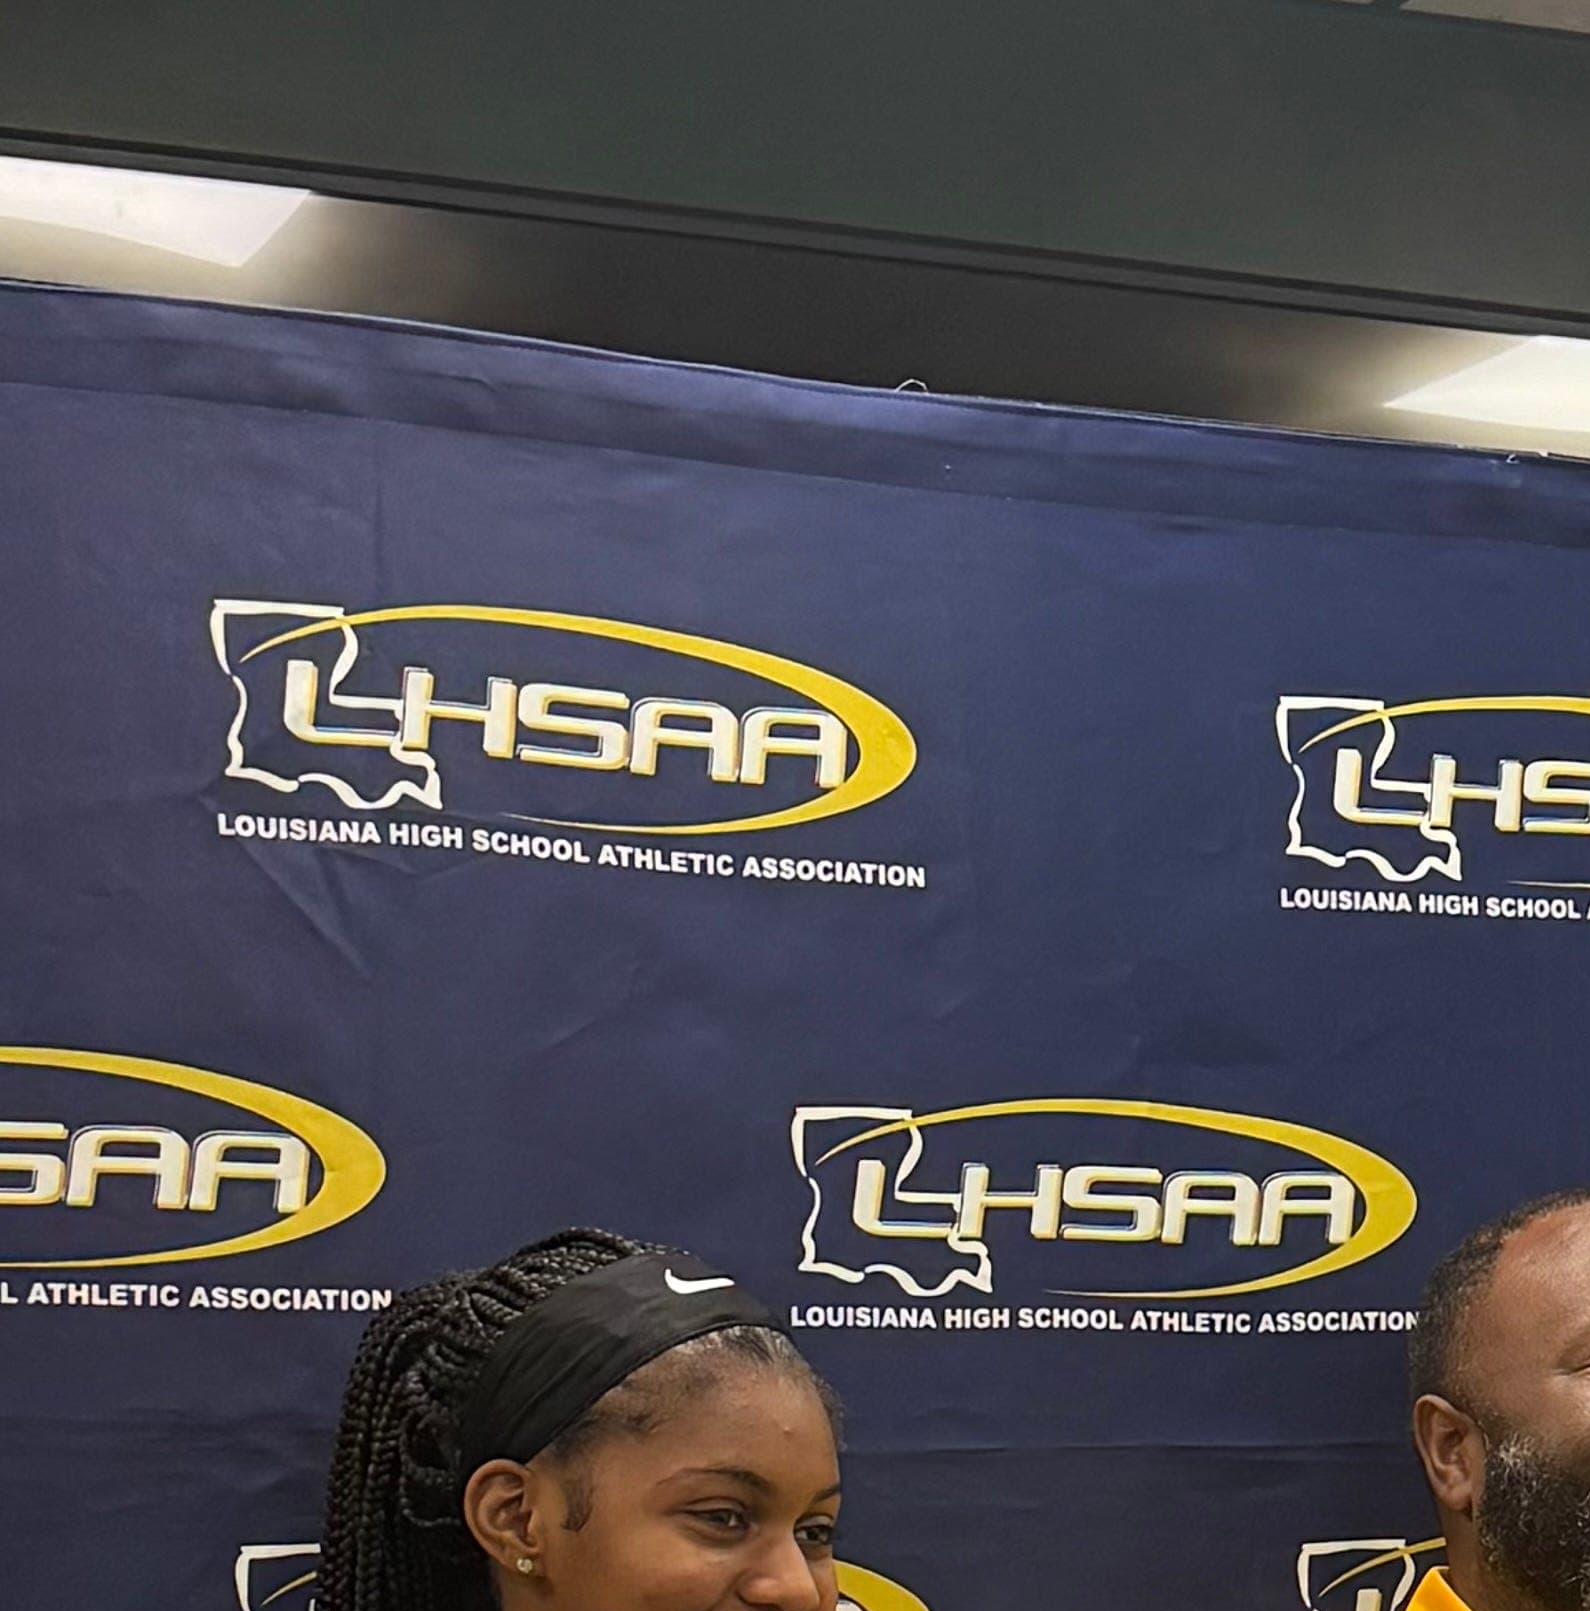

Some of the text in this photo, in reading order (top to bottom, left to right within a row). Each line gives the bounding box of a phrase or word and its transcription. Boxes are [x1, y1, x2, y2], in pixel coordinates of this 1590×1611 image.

[283, 659, 854, 789] LHSAA
[217, 812, 926, 888] LOUISIANA HIGH SCHOOL ATHLETIC ASSOCIATION
[1280, 887, 1413, 913] LOUISIANA
[1418, 893, 1479, 916] HIGH
[1486, 896, 1582, 919] SCHOOL
[853, 1159, 1358, 1246] LHSAA
[26, 1282, 180, 1307] ATHLETIC
[188, 1286, 392, 1311] ASSOCIATION
[790, 1305, 1420, 1334] LOUISIANA HIGH SCHOOL ATHLETIC ASSOCIATION
